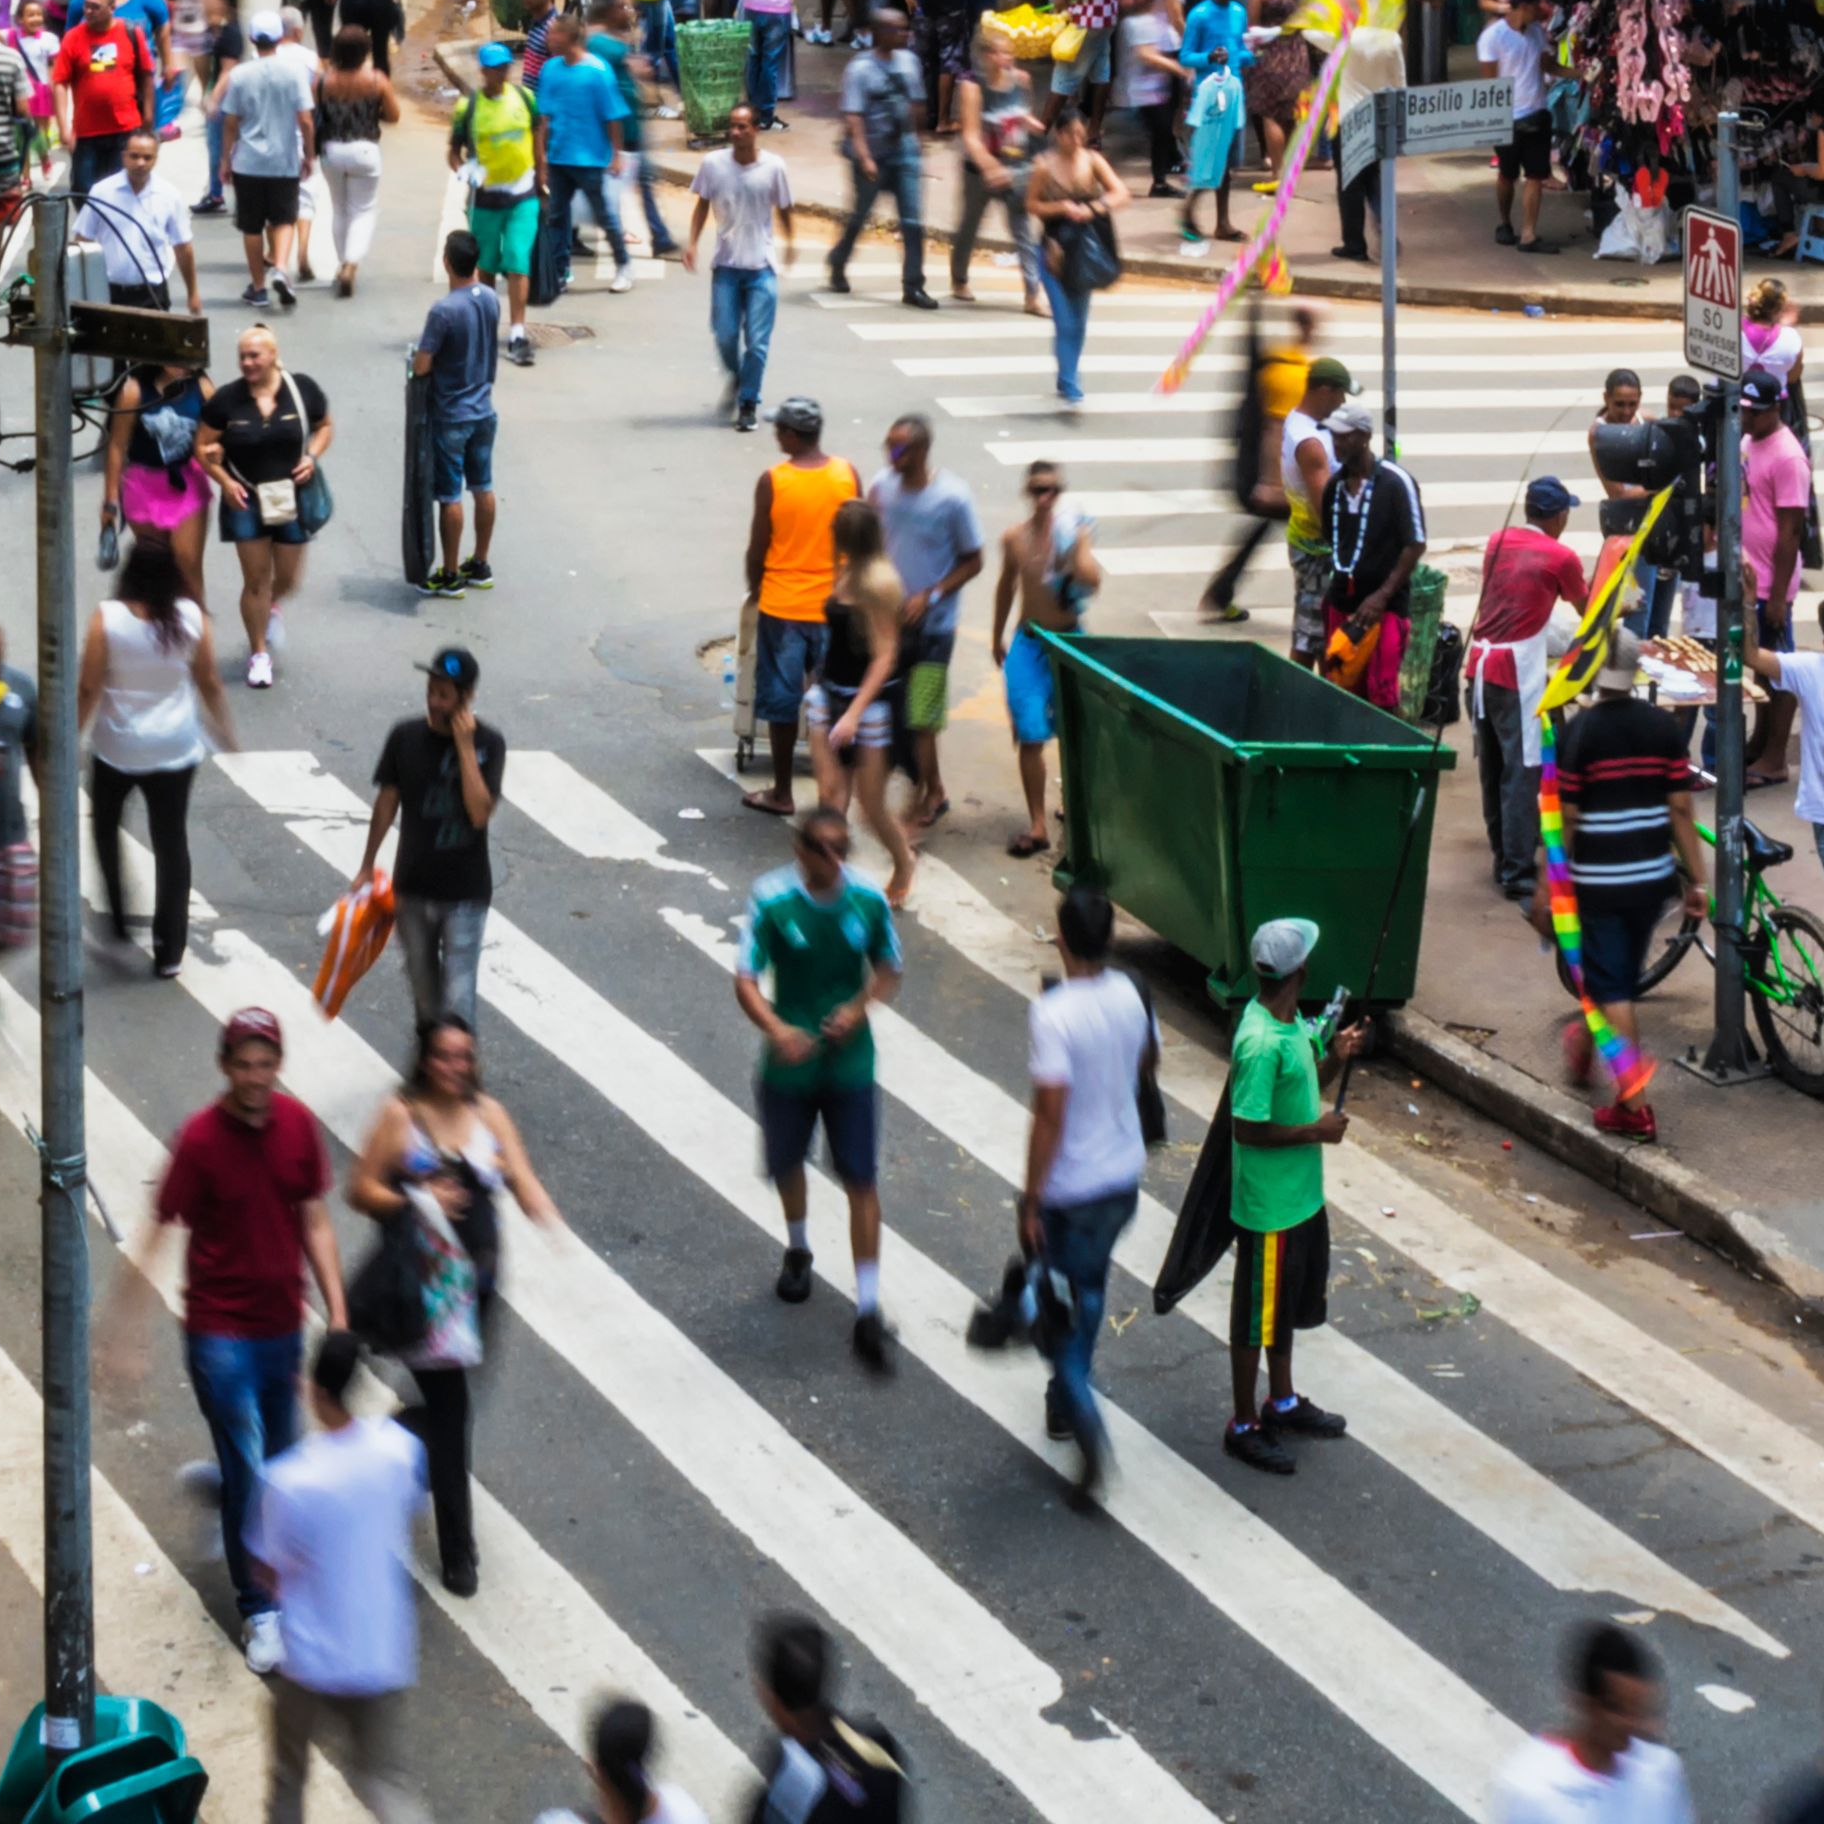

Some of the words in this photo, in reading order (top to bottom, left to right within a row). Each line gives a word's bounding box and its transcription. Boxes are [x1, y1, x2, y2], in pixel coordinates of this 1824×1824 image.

[1407, 88, 1463, 116] Basílio
[1469, 84, 1513, 110] Jafet
[1703, 306, 1724, 331] SÓ
[1688, 327, 1738, 356] ATRAVESSE
[1689, 343, 1703, 359] NO
[1705, 349, 1737, 372] VERDE
